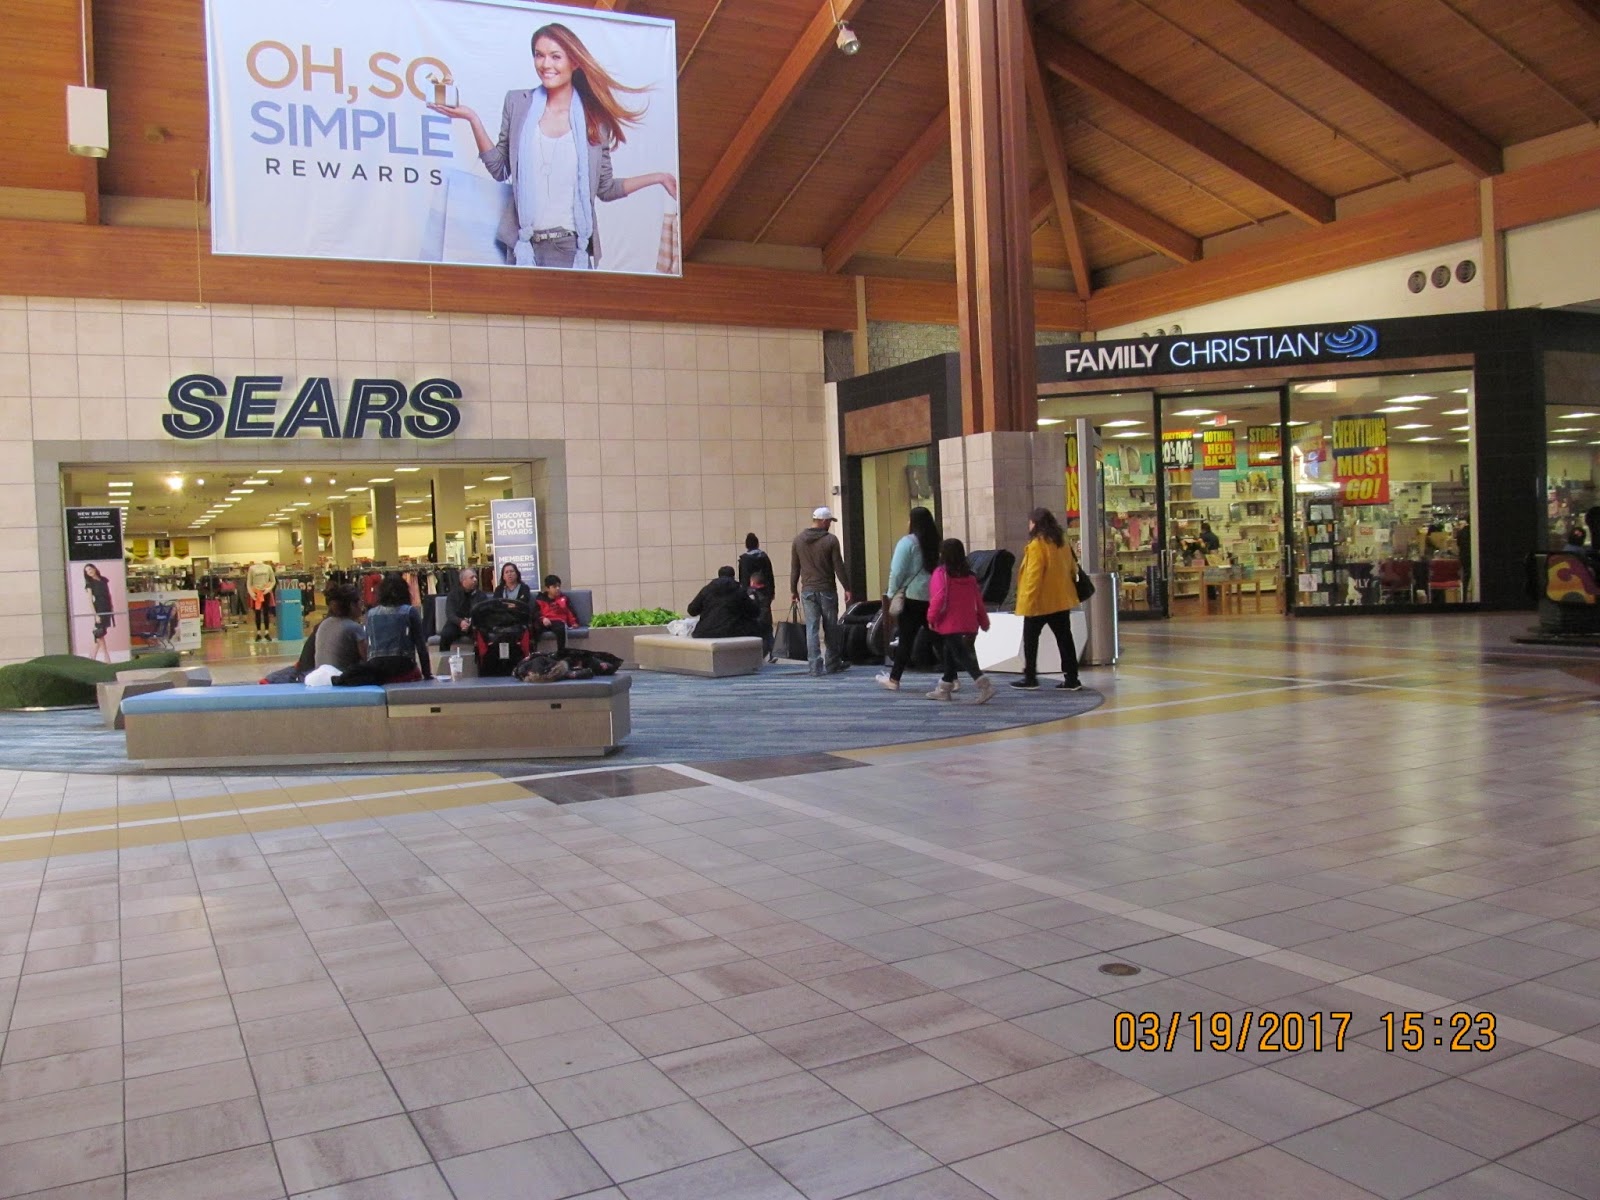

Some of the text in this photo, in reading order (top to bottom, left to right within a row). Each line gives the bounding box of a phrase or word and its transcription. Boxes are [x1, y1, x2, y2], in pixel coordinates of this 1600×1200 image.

[246, 39, 453, 105] OH, SO
[251, 100, 454, 158] SIMPLE
[265, 157, 443, 186] REWARDS
[1065, 332, 1321, 373] FAMILY CHRISTIAN
[162, 373, 463, 439] SEARS
[1203, 430, 1234, 443] NOTHING
[1249, 427, 1279, 443] STORE
[1332, 417, 1387, 449] EVERYTHING
[1207, 443, 1232, 454] HELD
[1204, 454, 1236, 467] BACK!
[1337, 453, 1386, 477] MUST
[1345, 478, 1382, 501] GO!
[496, 511, 532, 519] DISCOVER
[497, 518, 533, 529] MORE
[498, 528, 534, 536] REWARDS
[498, 554, 535, 563] MEMBERS
